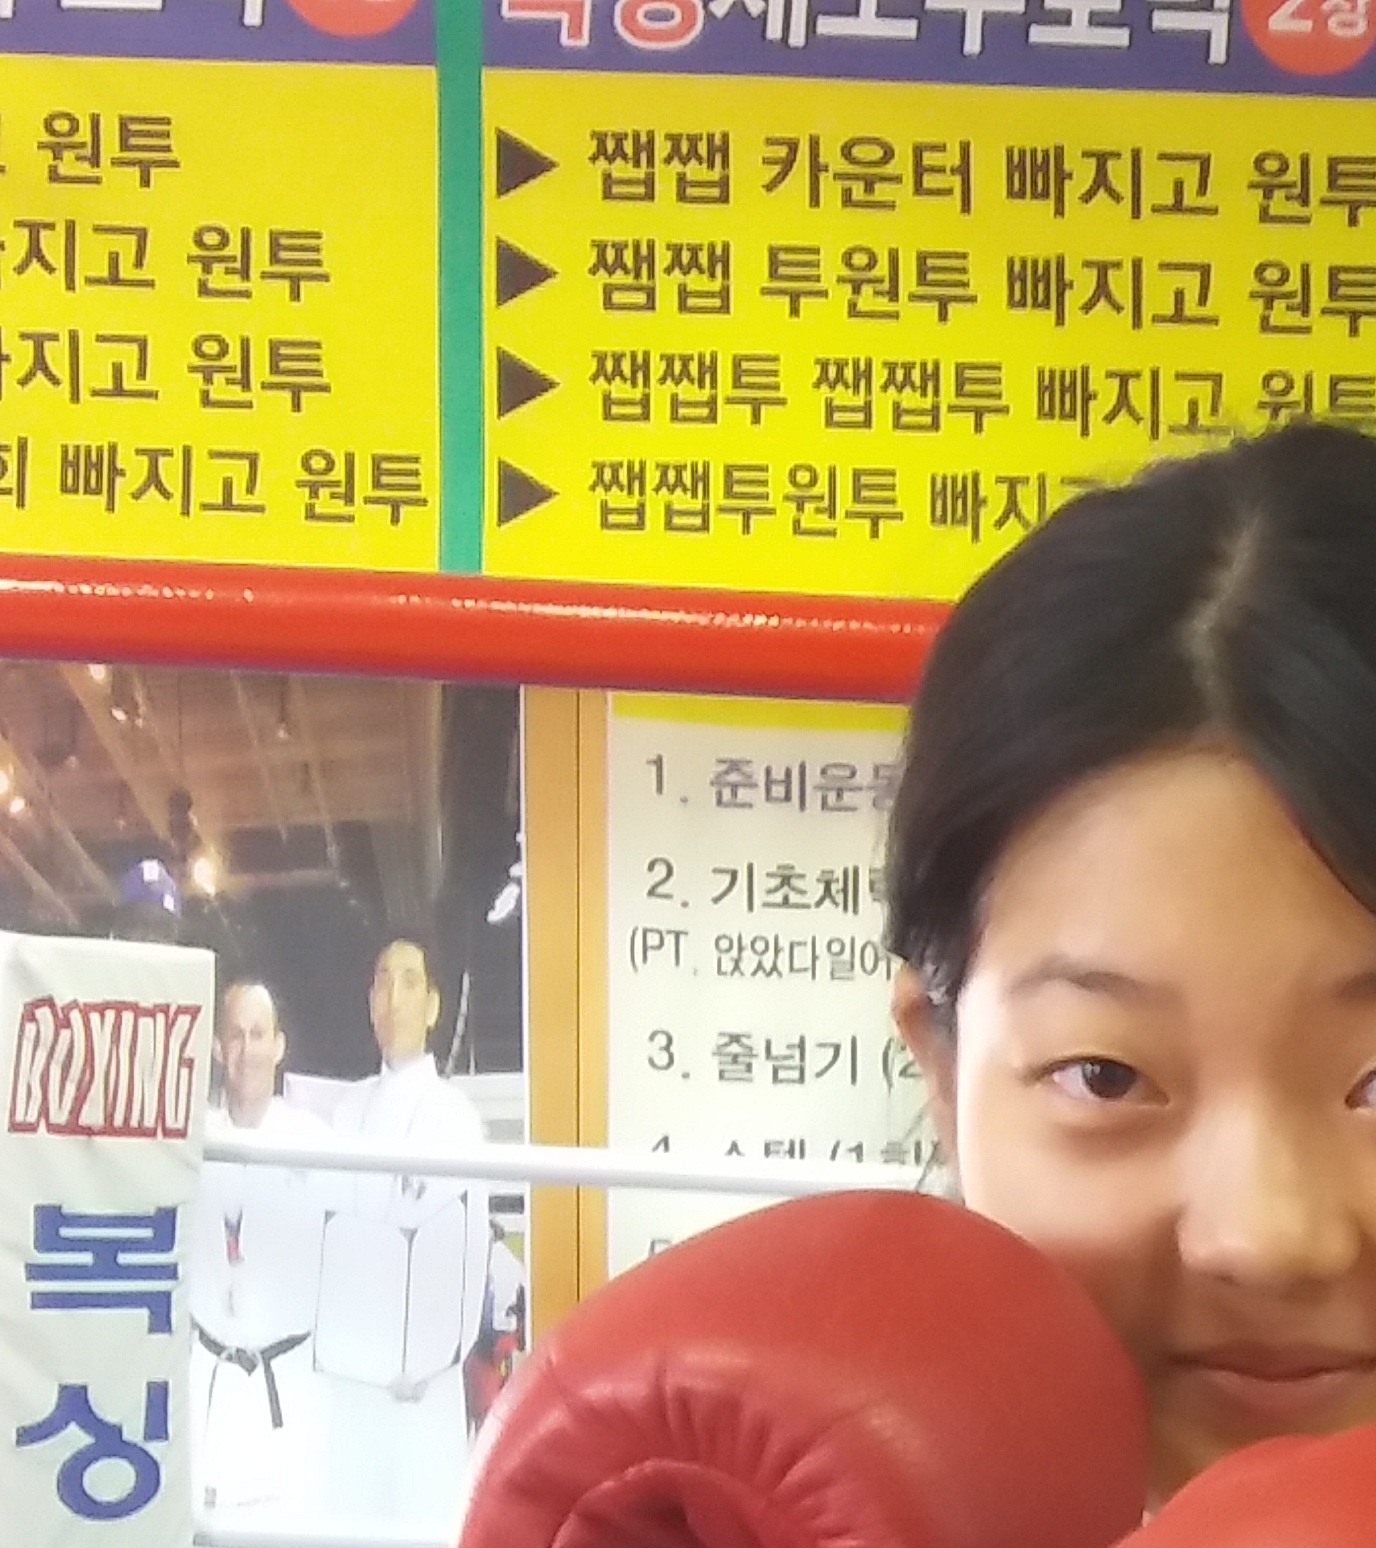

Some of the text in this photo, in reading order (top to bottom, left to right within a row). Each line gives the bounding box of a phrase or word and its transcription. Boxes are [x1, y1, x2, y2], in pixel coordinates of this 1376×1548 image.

[36, 111, 181, 189] 원투
[587, 129, 731, 205] 쨉쨉
[761, 133, 972, 215] 카운터
[1005, 144, 1219, 221] 빠지고
[0, 218, 331, 303] 지고 원투
[587, 238, 731, 315] 쨈쨉
[759, 244, 978, 324] 투원투
[1006, 253, 1220, 330] 빠지고
[0, 328, 332, 414] 지고 원투
[588, 349, 788, 426] 쨉쨉투
[812, 356, 1010, 435] 쨉쨉투
[1035, 361, 1231, 440] 빠지고
[59, 441, 266, 518] 빠지고
[295, 448, 429, 526] 원투
[588, 459, 904, 540] 쨉쨉투원투
[646, 753, 691, 805] 1.
[645, 857, 691, 910] 2.
[8, 996, 203, 1140] BOXING
[646, 1029, 861, 1086] 3. 줄넘기
